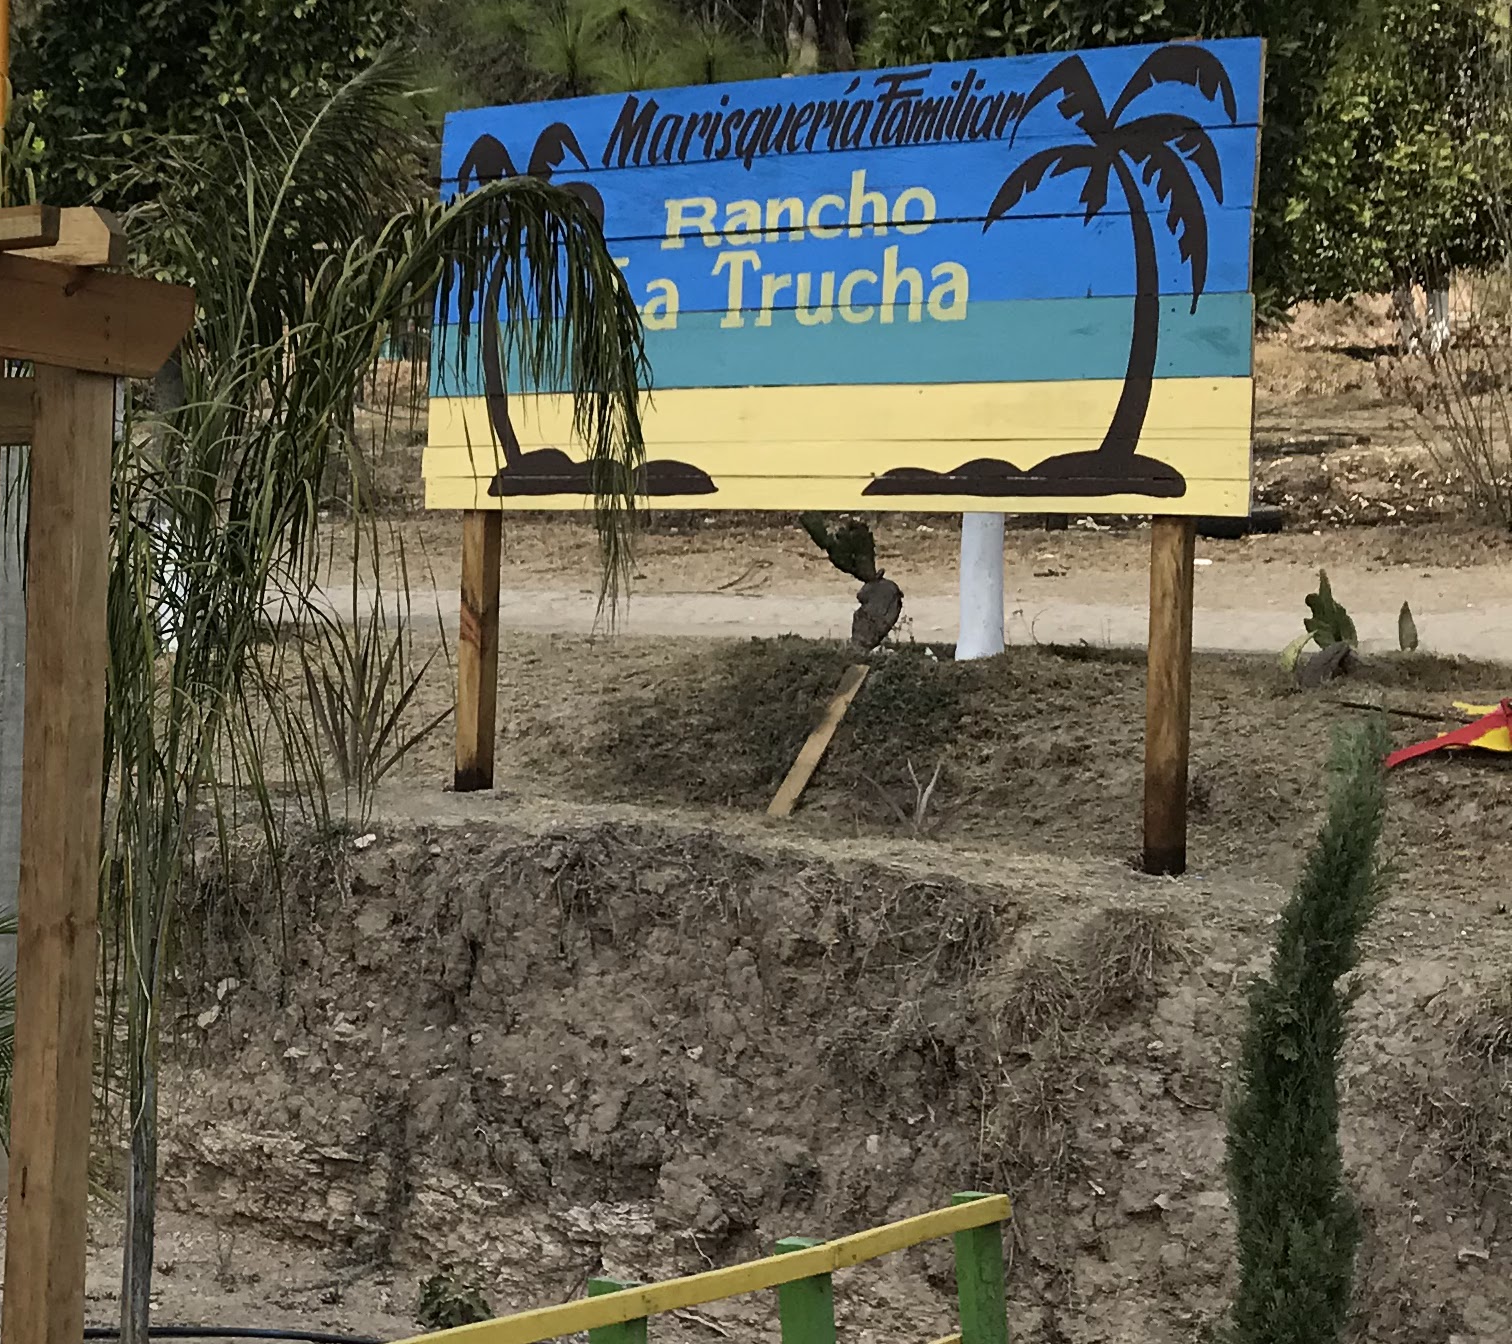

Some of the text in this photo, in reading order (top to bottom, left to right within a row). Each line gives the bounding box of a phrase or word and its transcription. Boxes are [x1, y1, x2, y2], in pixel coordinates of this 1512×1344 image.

[601, 68, 1026, 171] Marisquería Familiar
[660, 169, 937, 250] Rancho
[604, 245, 970, 331] a Trucha
